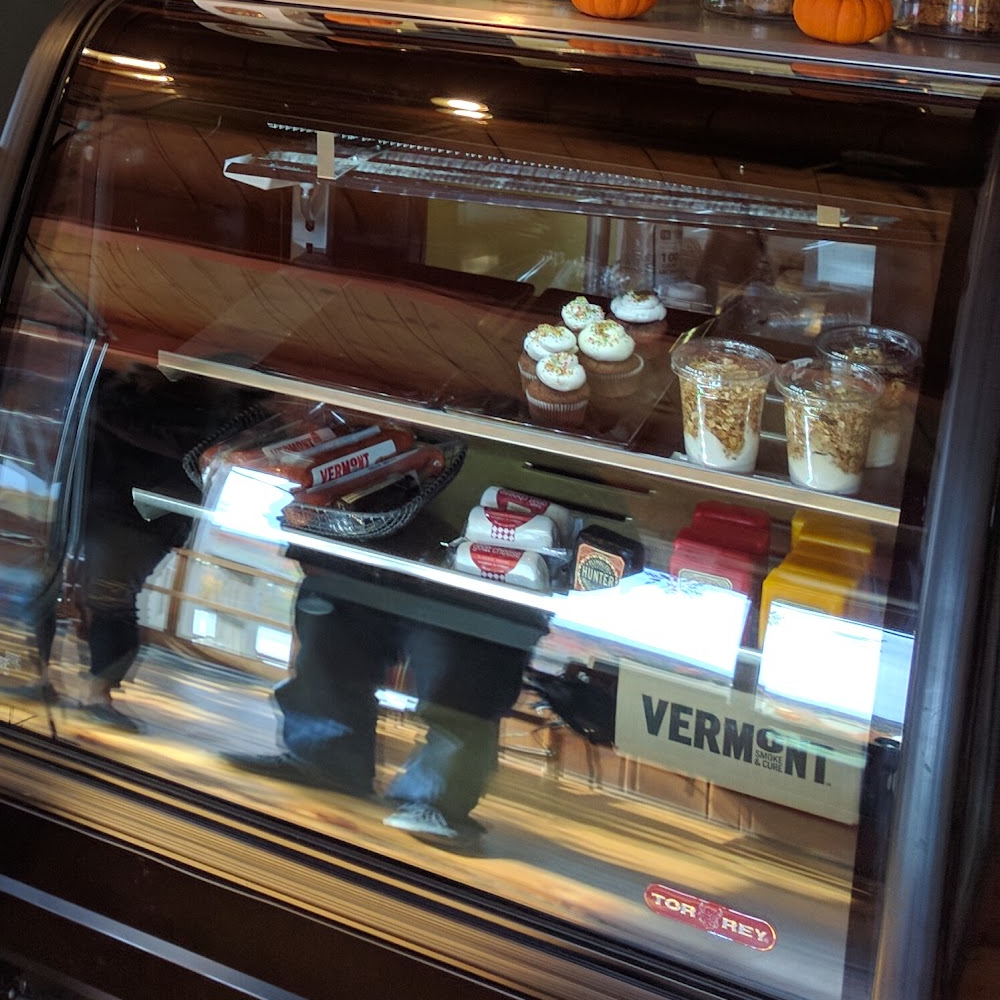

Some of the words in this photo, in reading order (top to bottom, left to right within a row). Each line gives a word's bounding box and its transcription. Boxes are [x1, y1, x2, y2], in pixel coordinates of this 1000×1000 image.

[320, 453, 370, 483] VERMONT
[582, 566, 614, 586] HUNTER
[642, 694, 834, 785] VERMONT
[755, 750, 783, 764] SMOKE
[763, 760, 783, 773] CURE
[651, 892, 697, 917] TOR
[721, 917, 768, 943] REY
